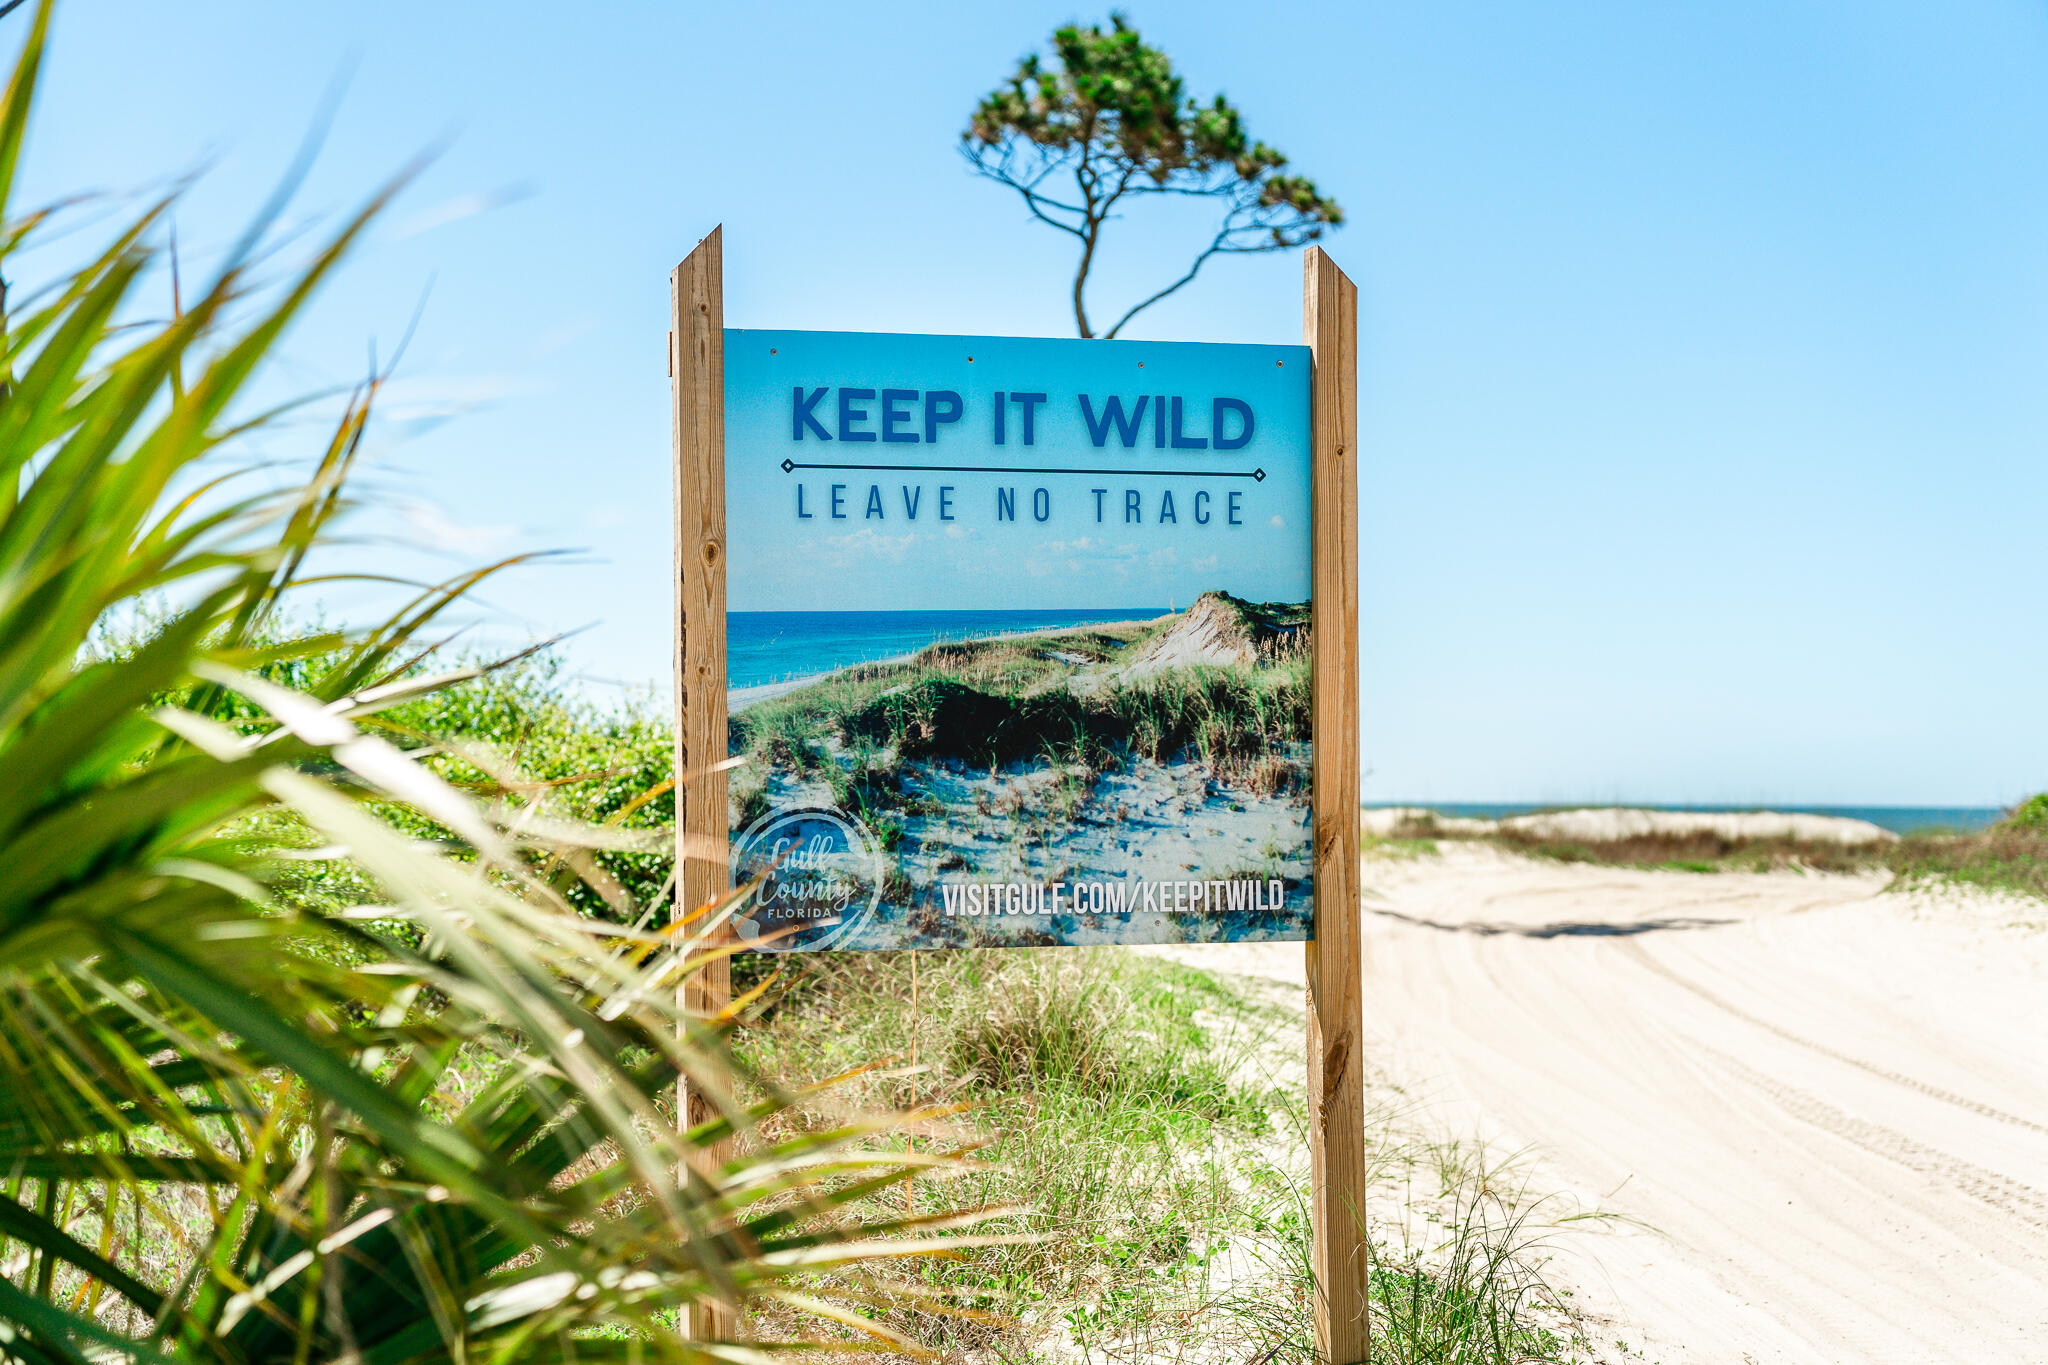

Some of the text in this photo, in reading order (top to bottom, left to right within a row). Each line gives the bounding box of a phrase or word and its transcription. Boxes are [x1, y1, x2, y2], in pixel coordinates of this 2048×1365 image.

[792, 386, 1255, 450] KEEP IT WILD
[797, 484, 1243, 525] LEAVE NO TRACE
[771, 834, 833, 874] Gulf
[756, 870, 856, 912] County
[942, 879, 1284, 917] VISITGULF.COM/KEEPITWILD
[768, 908, 832, 919] FLORIDA
